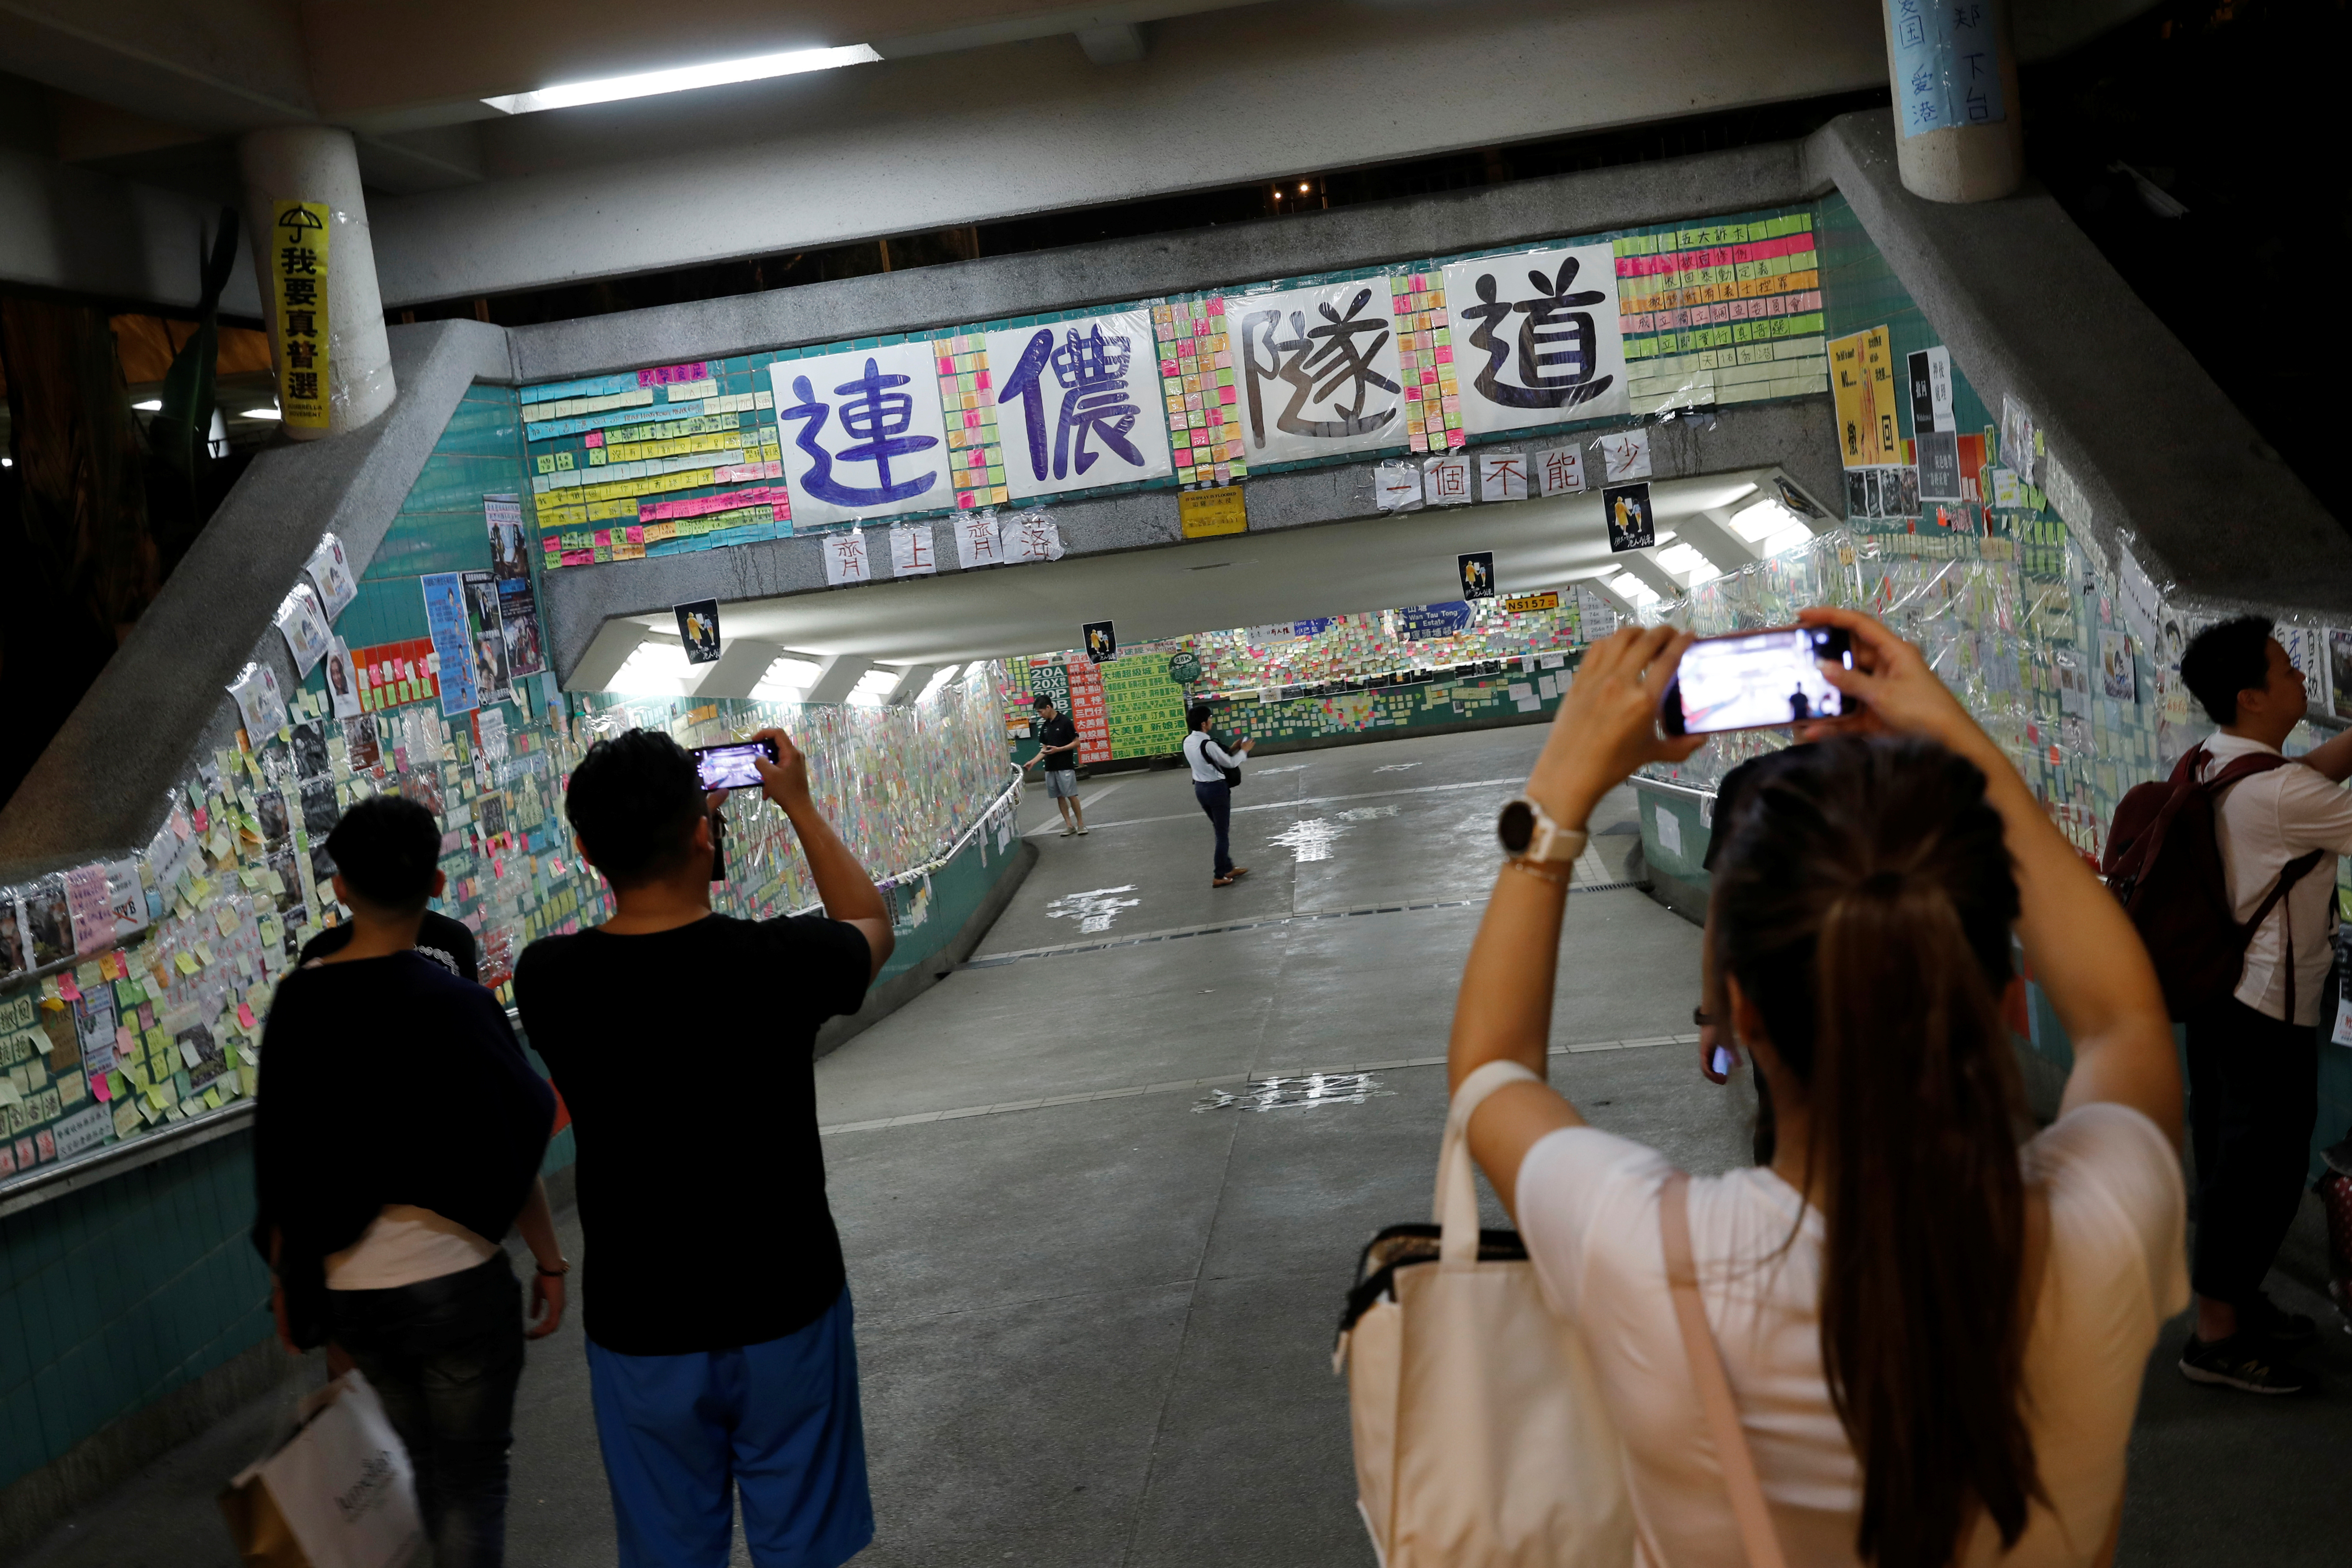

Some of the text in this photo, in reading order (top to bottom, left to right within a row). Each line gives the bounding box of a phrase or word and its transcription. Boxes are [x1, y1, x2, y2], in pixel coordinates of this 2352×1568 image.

[1680, 228, 1745, 245] 五大訴求
[1681, 248, 1746, 268] 撤回修例
[282, 247, 318, 401] 我要真普選
[1387, 442, 1640, 496] 一個不能少
[832, 519, 1051, 578] 齊上齊落
[1509, 599, 1545, 610] NS157
[1423, 619, 1445, 627] Estate
[1411, 626, 1452, 640] 運頭塘邨
[1031, 667, 1064, 679] 20A
[1032, 678, 1059, 690] 20X
[1059, 677, 1067, 686] 特快
[1076, 707, 1103, 717] 三門仔
[1151, 720, 1186, 731] 新娘潭
[115, 901, 136, 917] TVB
